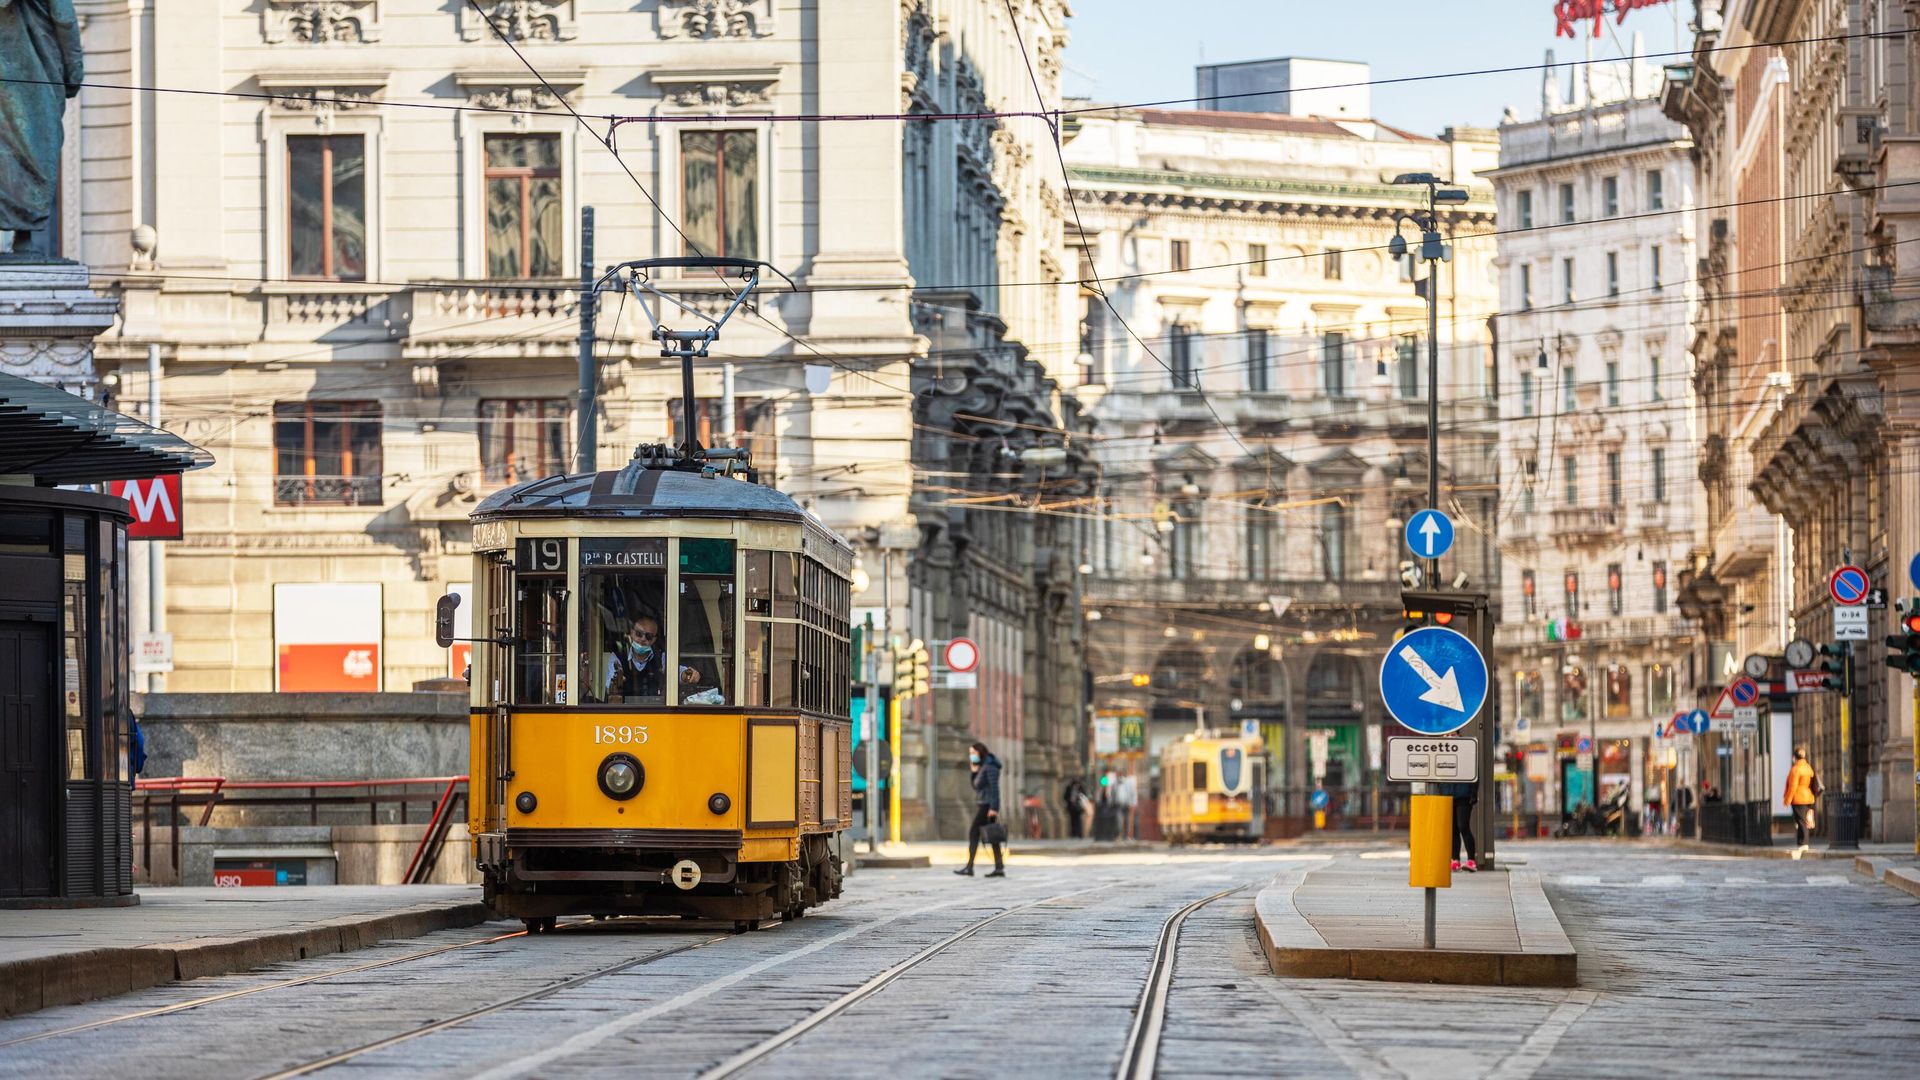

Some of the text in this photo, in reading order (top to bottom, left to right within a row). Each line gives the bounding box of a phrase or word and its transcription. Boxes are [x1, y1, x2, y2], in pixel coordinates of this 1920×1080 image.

[121, 479, 176, 522] M
[530, 539, 561, 570] 19
[605, 552, 613, 565] P.
[616, 552, 663, 565] CASTELLI
[594, 725, 648, 744] 1895
[1406, 742, 1459, 752] eccetto
